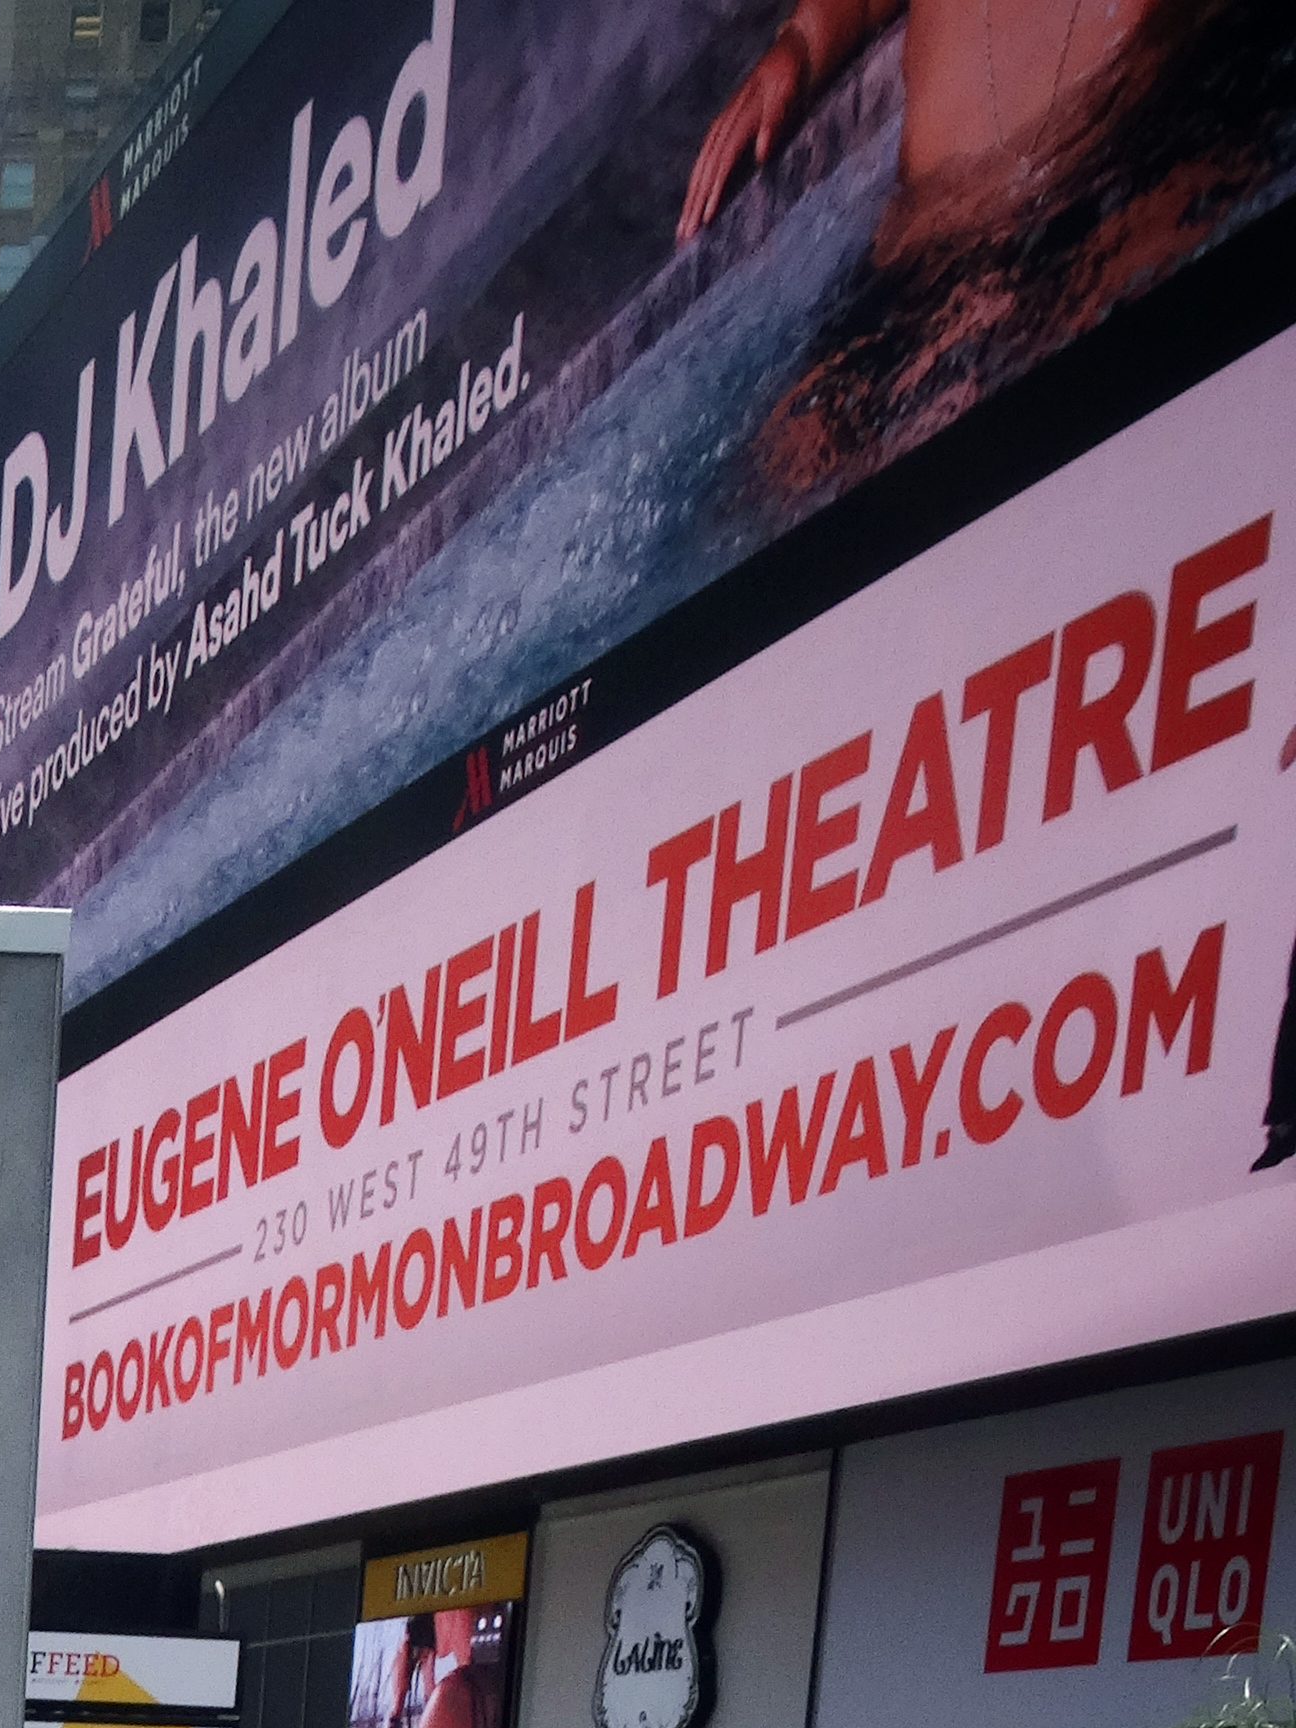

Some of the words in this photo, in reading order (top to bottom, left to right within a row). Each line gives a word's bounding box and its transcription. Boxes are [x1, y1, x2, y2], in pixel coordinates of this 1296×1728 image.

[119, 113, 190, 221] MARQUIS
[123, 54, 203, 179] MARRIOTT
[108, 0, 455, 526] Khaled
[71, 523, 187, 681] Grateful,
[194, 488, 239, 569] the
[246, 424, 314, 523] new
[319, 307, 428, 453] album
[28, 659, 143, 827] produced
[146, 640, 187, 714] by
[184, 541, 282, 681] Asahd
[289, 456, 375, 589] Tuck
[378, 310, 530, 511] Khaled.
[499, 724, 579, 793] MARQUIS
[502, 677, 593, 749] MARRIOTT
[70, 1034, 309, 1269] EUGENE
[319, 880, 620, 1149] O'NEILL
[645, 511, 1275, 999] THEATRE
[61, 922, 1228, 1444] BOOKOFMORMONBROADWAY.COM
[254, 1208, 309, 1263] 230
[326, 1148, 424, 1233] WEST
[444, 1086, 546, 1180] 49TH
[566, 1007, 756, 1137] STREET
[1011, 1488, 1097, 1563] ユニ
[1157, 1462, 1255, 1547] UNI
[396, 1550, 485, 1601] INVICTA
[999, 1574, 1091, 1647] クロ
[1147, 1554, 1252, 1647] QLO
